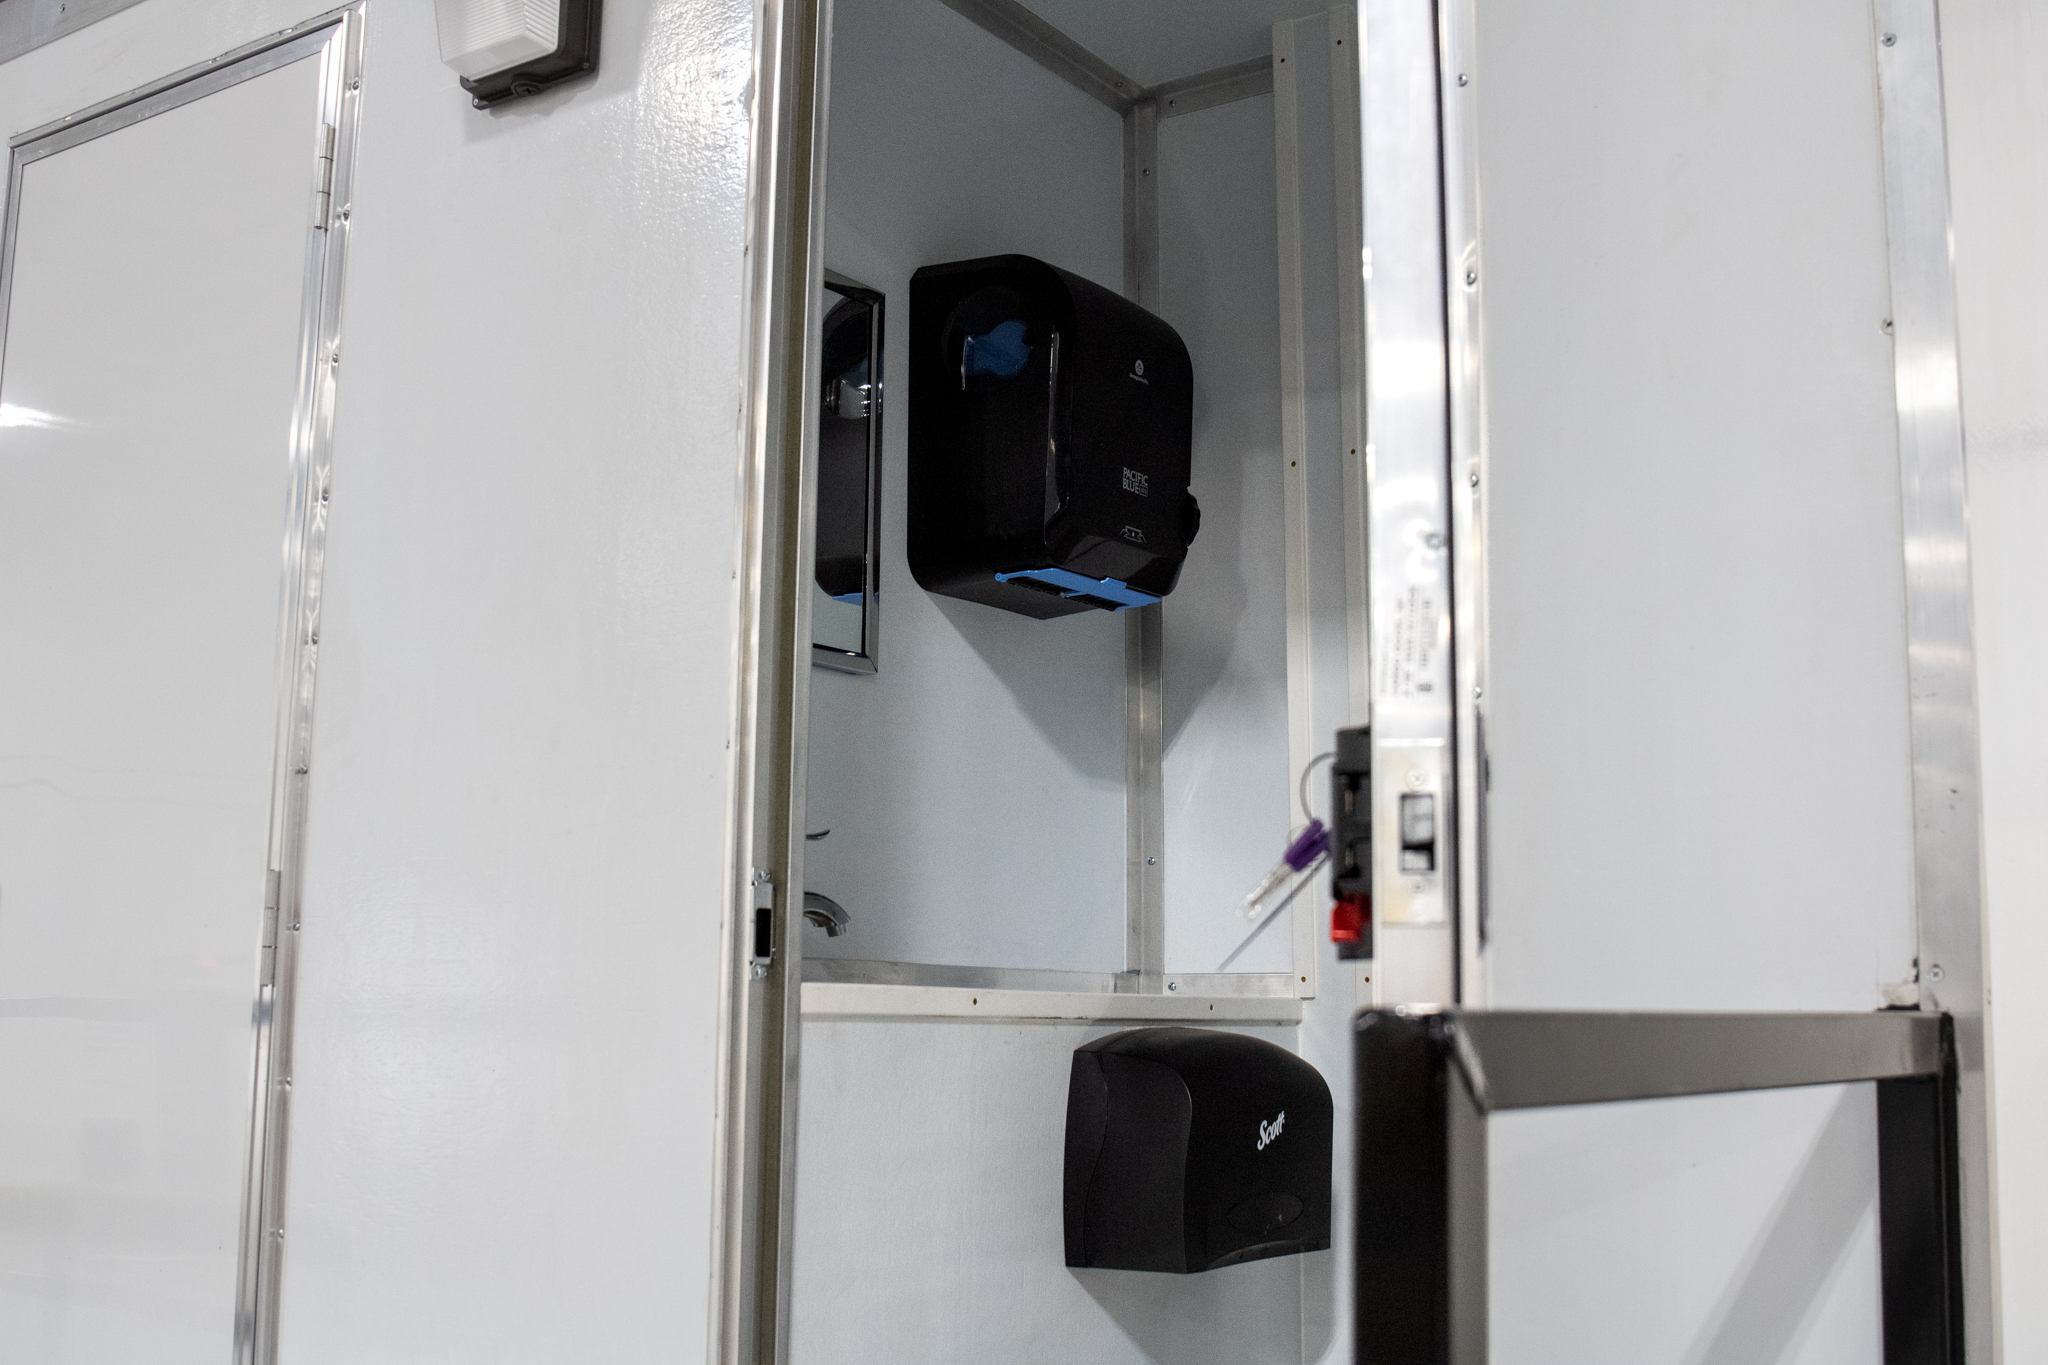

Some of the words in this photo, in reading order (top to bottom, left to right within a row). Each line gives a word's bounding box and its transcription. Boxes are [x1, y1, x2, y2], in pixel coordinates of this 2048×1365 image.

[1122, 466, 1149, 486] PACIFIC
[1122, 477, 1140, 494] BLUE
[1257, 1110, 1285, 1151] Scott
